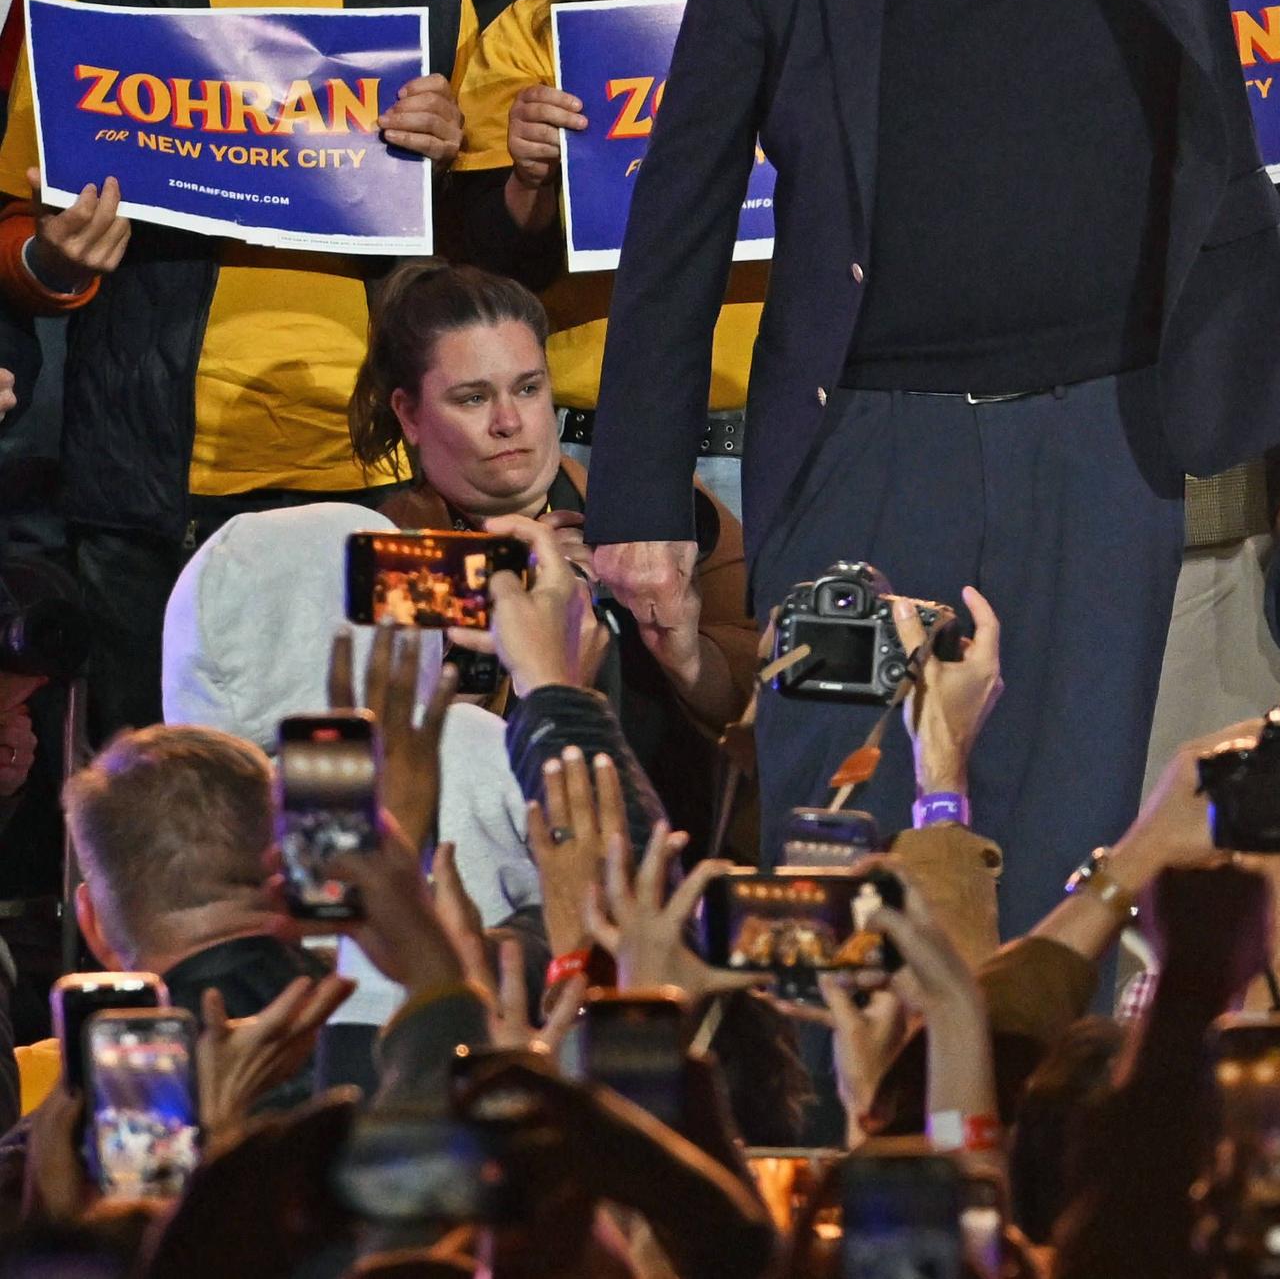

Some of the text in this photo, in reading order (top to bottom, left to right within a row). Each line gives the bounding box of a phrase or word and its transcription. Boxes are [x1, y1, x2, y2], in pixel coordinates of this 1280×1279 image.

[74, 63, 381, 135] ZOHRAN
[95, 128, 367, 170] FOR NEW YORK CITY
[168, 178, 290, 207] ZOHRANFORNYC.COM
